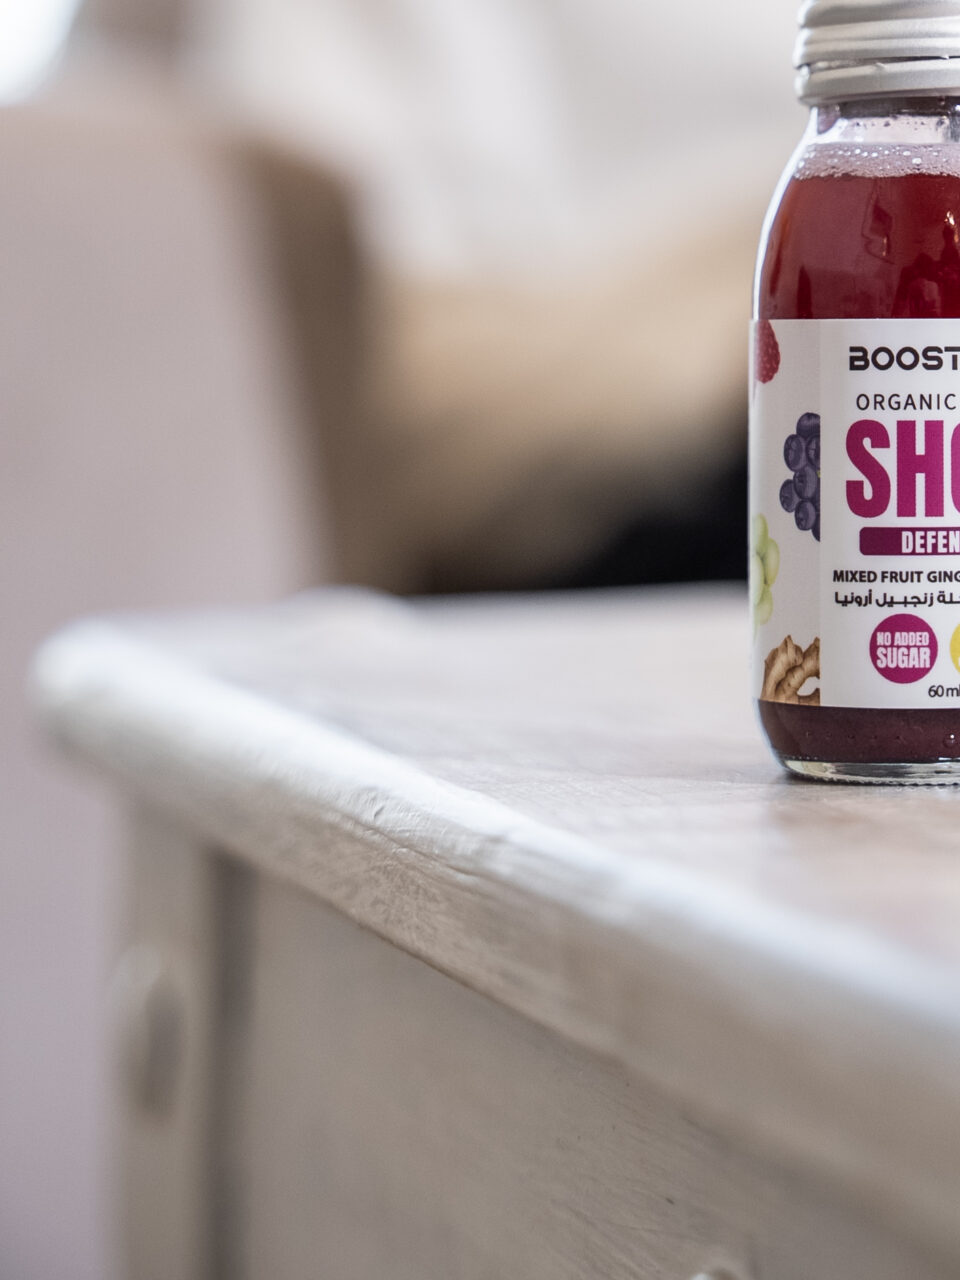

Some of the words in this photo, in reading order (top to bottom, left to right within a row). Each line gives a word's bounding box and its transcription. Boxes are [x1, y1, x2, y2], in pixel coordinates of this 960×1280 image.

[856, 393, 957, 411] ORGANIC
[832, 569, 878, 583] MIXED
[880, 570, 924, 583] FRUIT
[834, 588, 873, 607] أرونيا
[875, 592, 934, 608] زنجبيل
[876, 631, 892, 646] NO
[893, 631, 930, 646] ADDED
[876, 647, 931, 669] SUGAR
